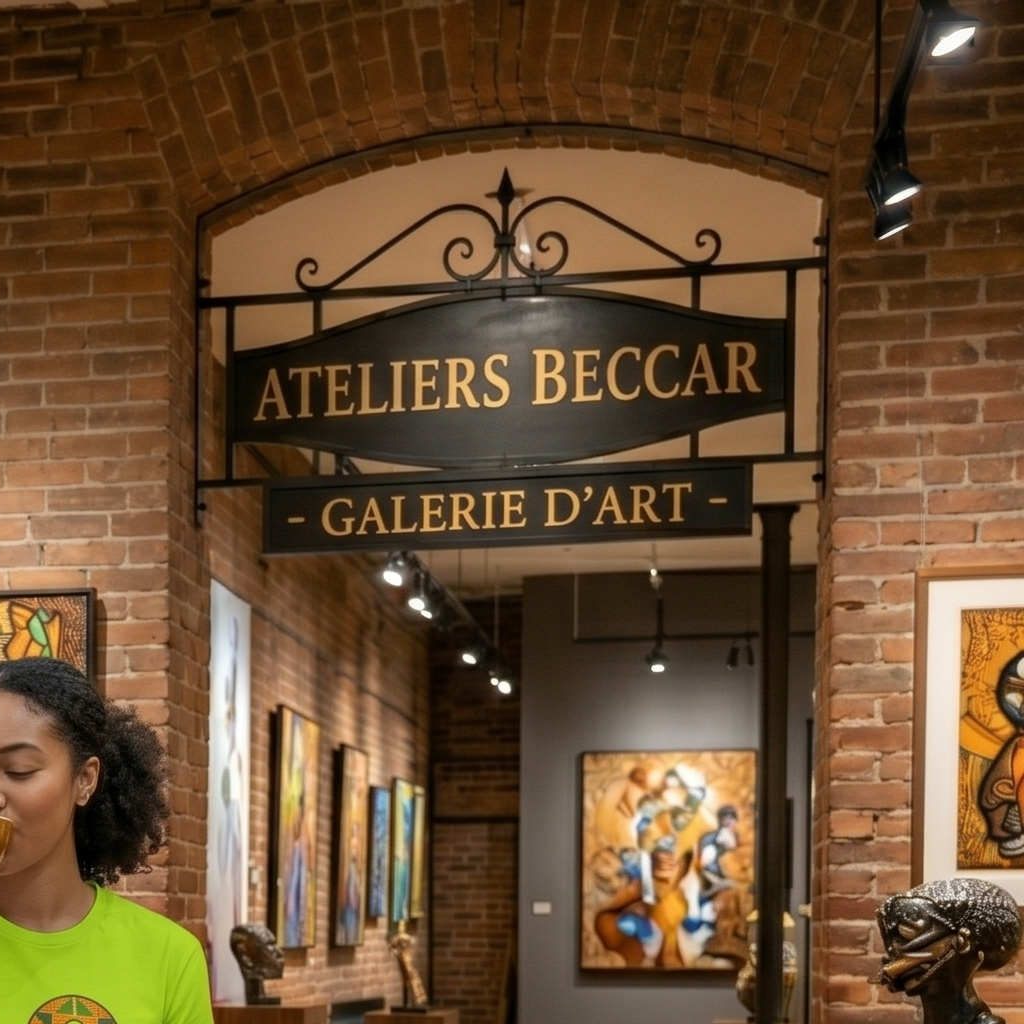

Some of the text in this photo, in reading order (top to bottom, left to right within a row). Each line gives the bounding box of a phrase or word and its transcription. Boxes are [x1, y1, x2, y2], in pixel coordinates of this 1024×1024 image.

[253, 342, 762, 421] ATELIERS BECCAR
[321, 490, 527, 536] GALERIE
[544, 483, 692, 527] D'ART
